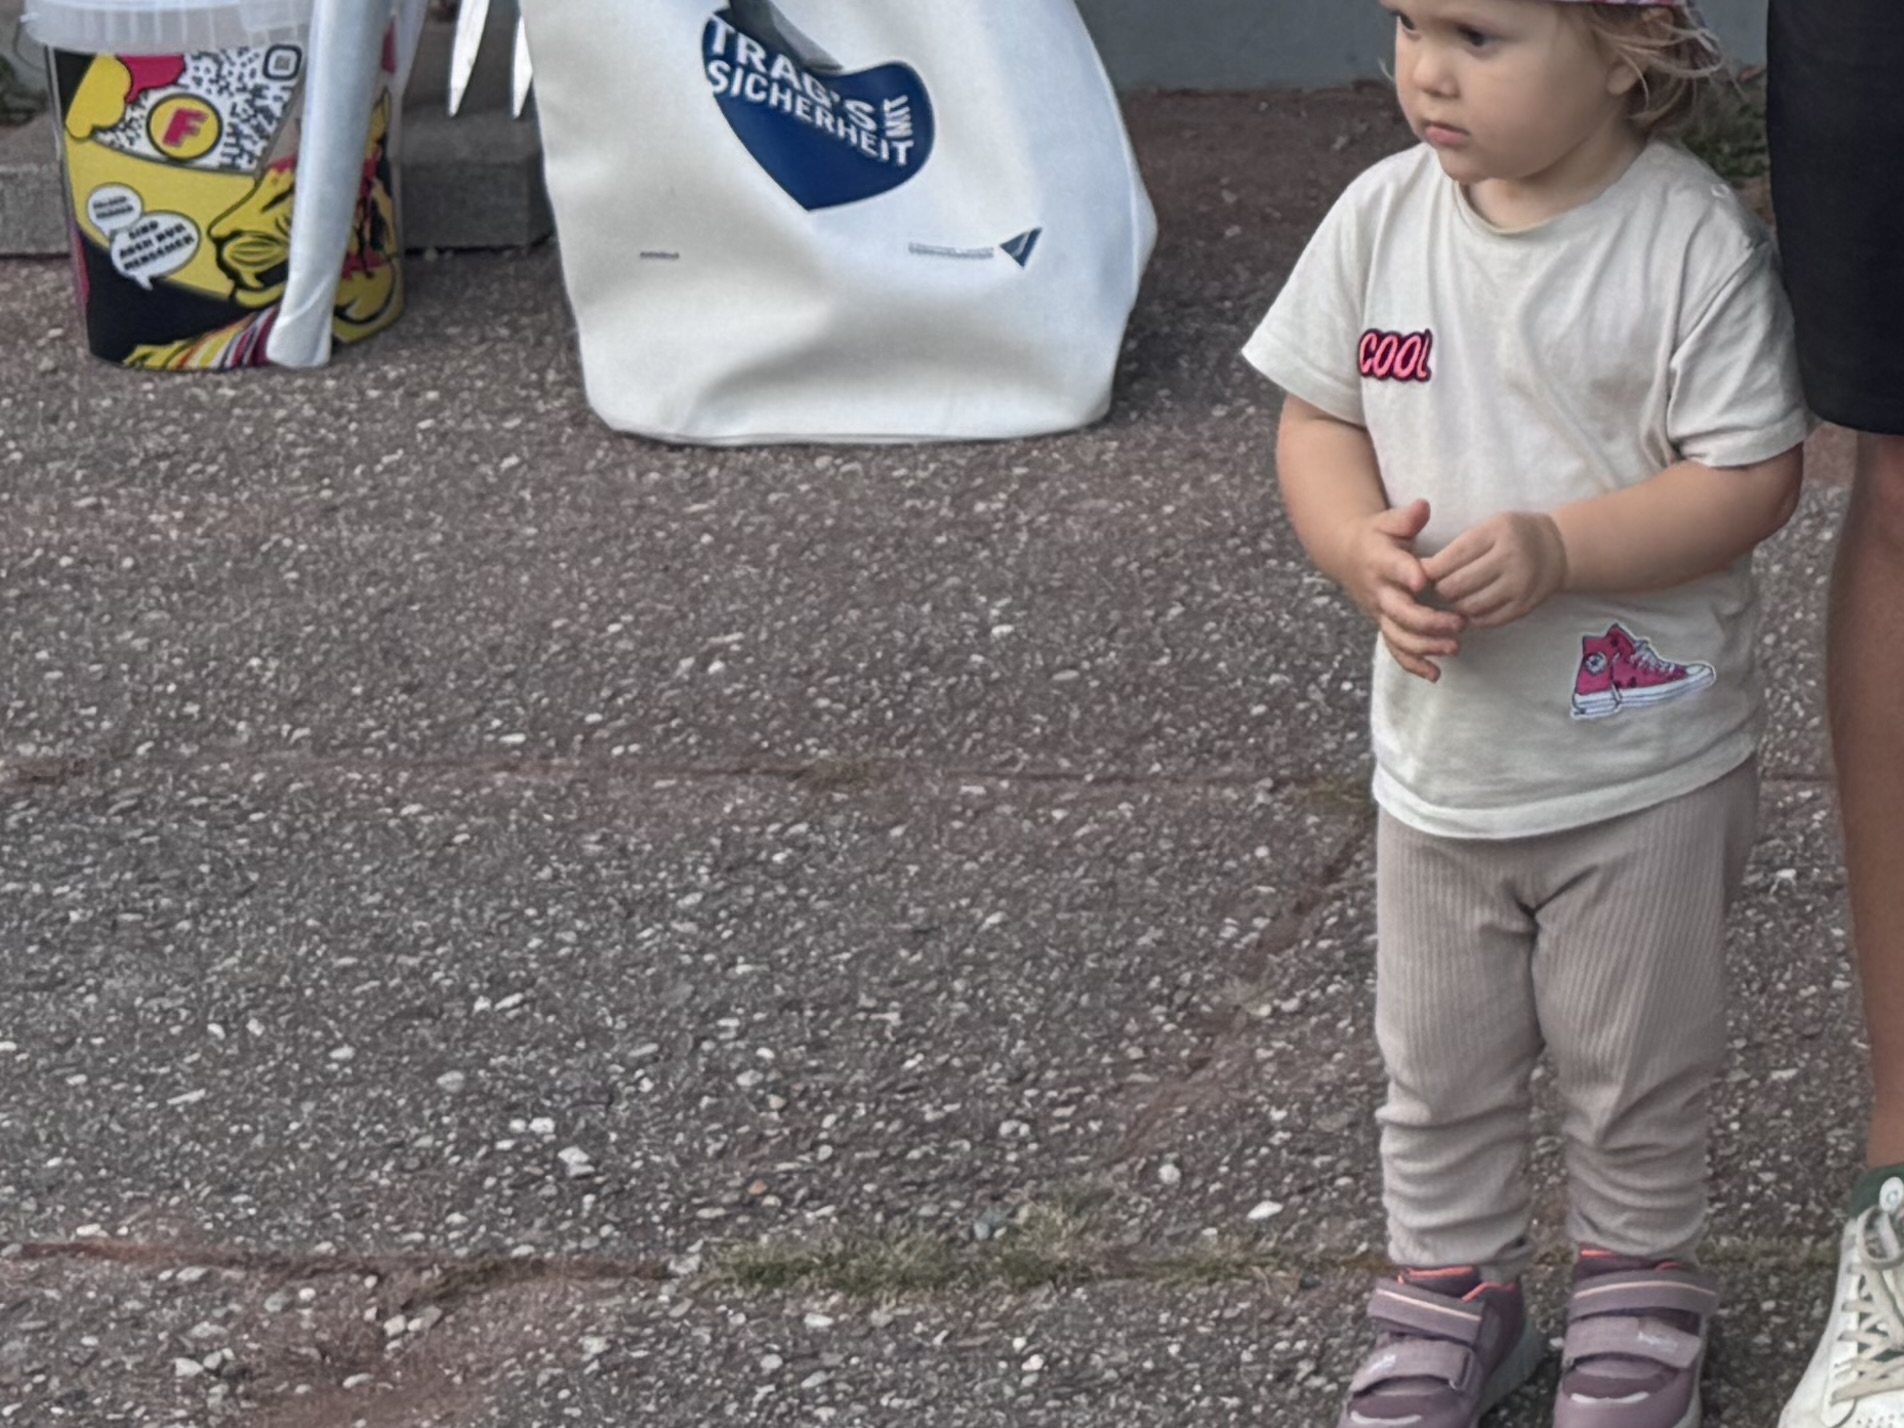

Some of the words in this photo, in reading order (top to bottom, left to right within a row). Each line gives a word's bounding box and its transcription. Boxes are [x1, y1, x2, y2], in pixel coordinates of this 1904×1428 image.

[707, 58, 916, 168] SICHERHEIT
[708, 14, 879, 133] TRAG'S
[161, 106, 210, 150] F
[1359, 328, 1433, 382] COOL
